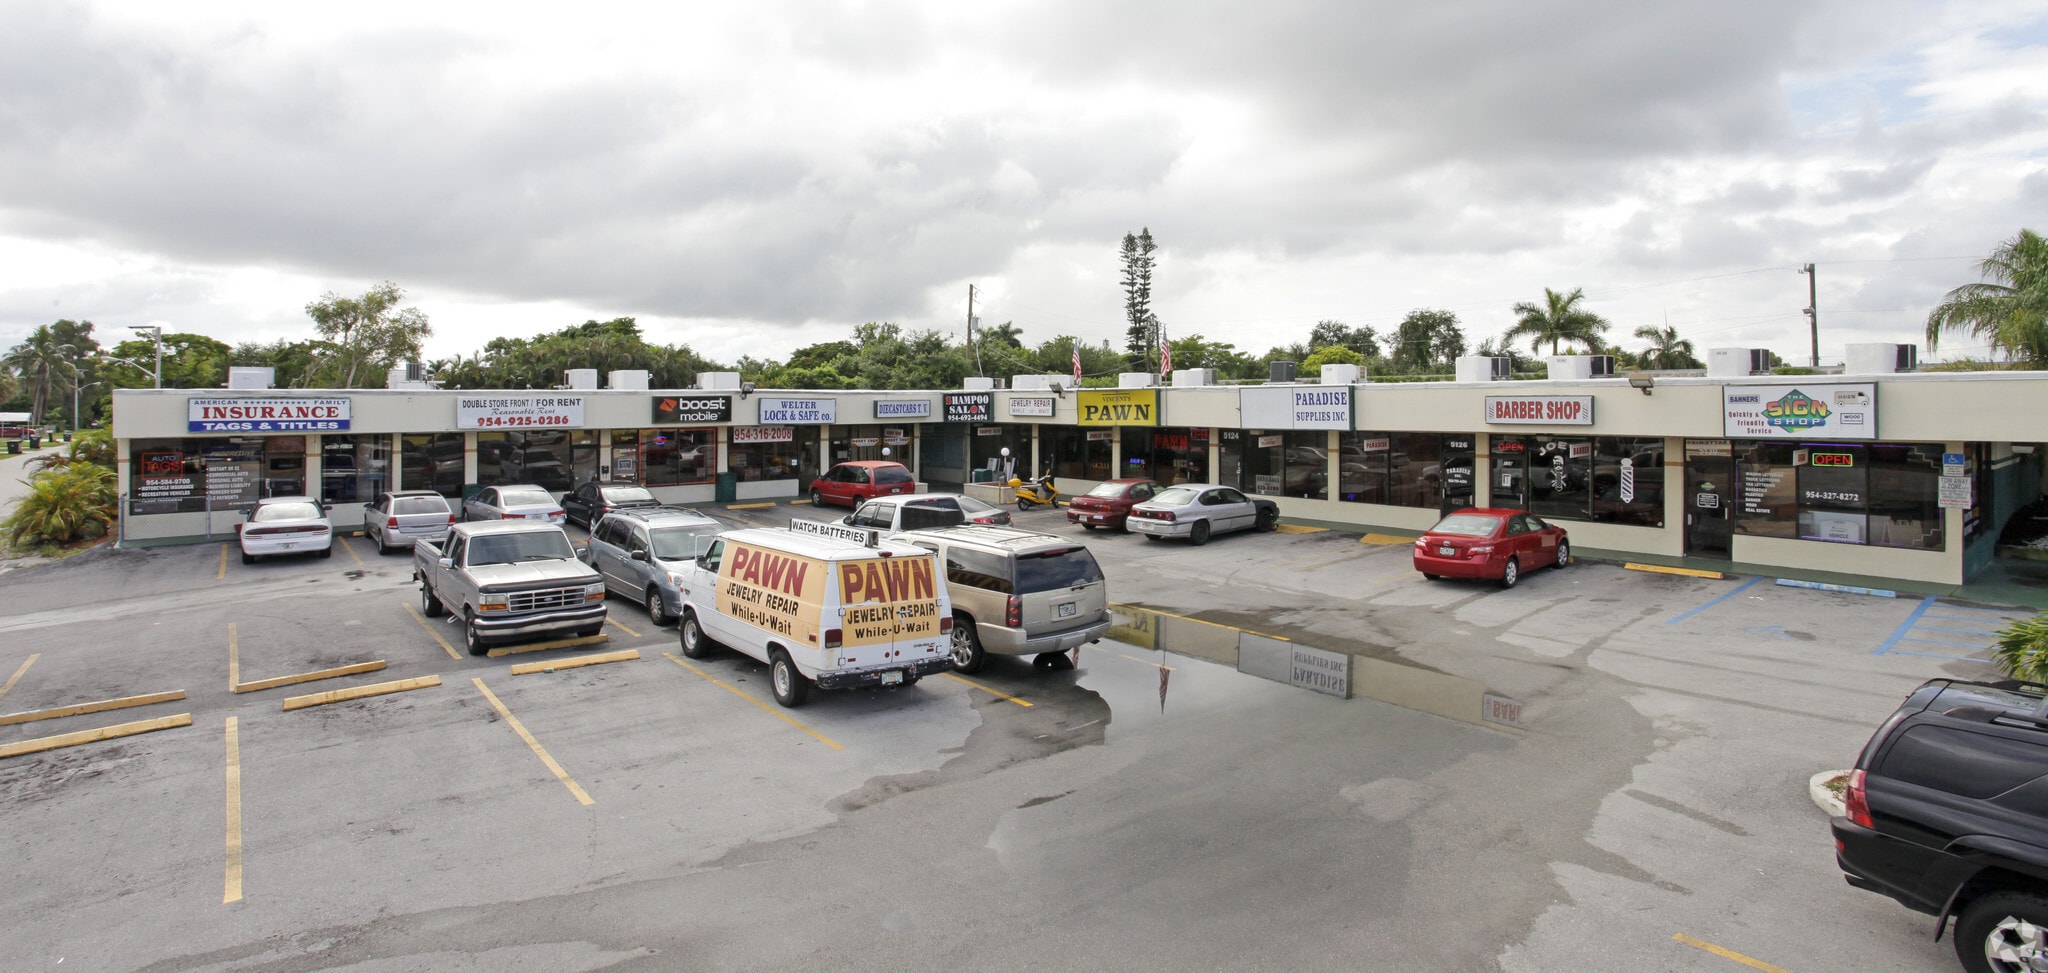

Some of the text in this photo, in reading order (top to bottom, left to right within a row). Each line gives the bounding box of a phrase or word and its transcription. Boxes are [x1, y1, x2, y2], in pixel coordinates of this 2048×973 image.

[462, 399, 487, 409] DOUBLE
[488, 399, 508, 408] STORE
[509, 399, 529, 408] FRONT
[536, 399, 554, 407] FOR
[557, 398, 582, 407] RENT
[679, 398, 726, 410] boost
[945, 395, 989, 404] SHAMPOO
[1011, 399, 1051, 408] JEWELRY REPAIR
[1295, 392, 1347, 406] PARADISE
[781, 401, 817, 409] WELTER
[918, 403, 924, 413] T.
[924, 403, 929, 413] V.
[949, 405, 986, 414] SALON
[1496, 401, 1581, 419] BARBER SHOP
[1766, 400, 1828, 417] SIGN
[202, 406, 340, 419] INSURANCE
[490, 407, 556, 416] Reasonable Rent
[680, 411, 719, 421] mobile
[764, 410, 832, 421] LOCK & SAFE co.
[1085, 404, 1150, 421] PAWN
[1296, 411, 1348, 422] SUPPLIES INC.
[477, 415, 569, 427] 954-925-0286
[947, 414, 988, 422] 954-692-4494
[202, 421, 339, 431] TAGS & TITLES
[734, 427, 792, 441] 954-316-2008
[1154, 434, 1188, 450] PAWN
[1498, 443, 1524, 451] OPEN
[1539, 441, 1568, 456] JOE
[1573, 446, 1590, 455] BARBER
[1815, 454, 1852, 465] OPEN
[145, 461, 180, 472] TAGS
[1446, 467, 1471, 475] PARADISE
[1806, 491, 1859, 501] 954-327-8272
[792, 521, 865, 544] WATCH BATTERIES
[730, 546, 809, 598] PAWN
[841, 558, 934, 604] PAWN
[726, 582, 799, 617] JEWELRY REPAIR
[847, 603, 936, 625] JEWELRY REPAIR
